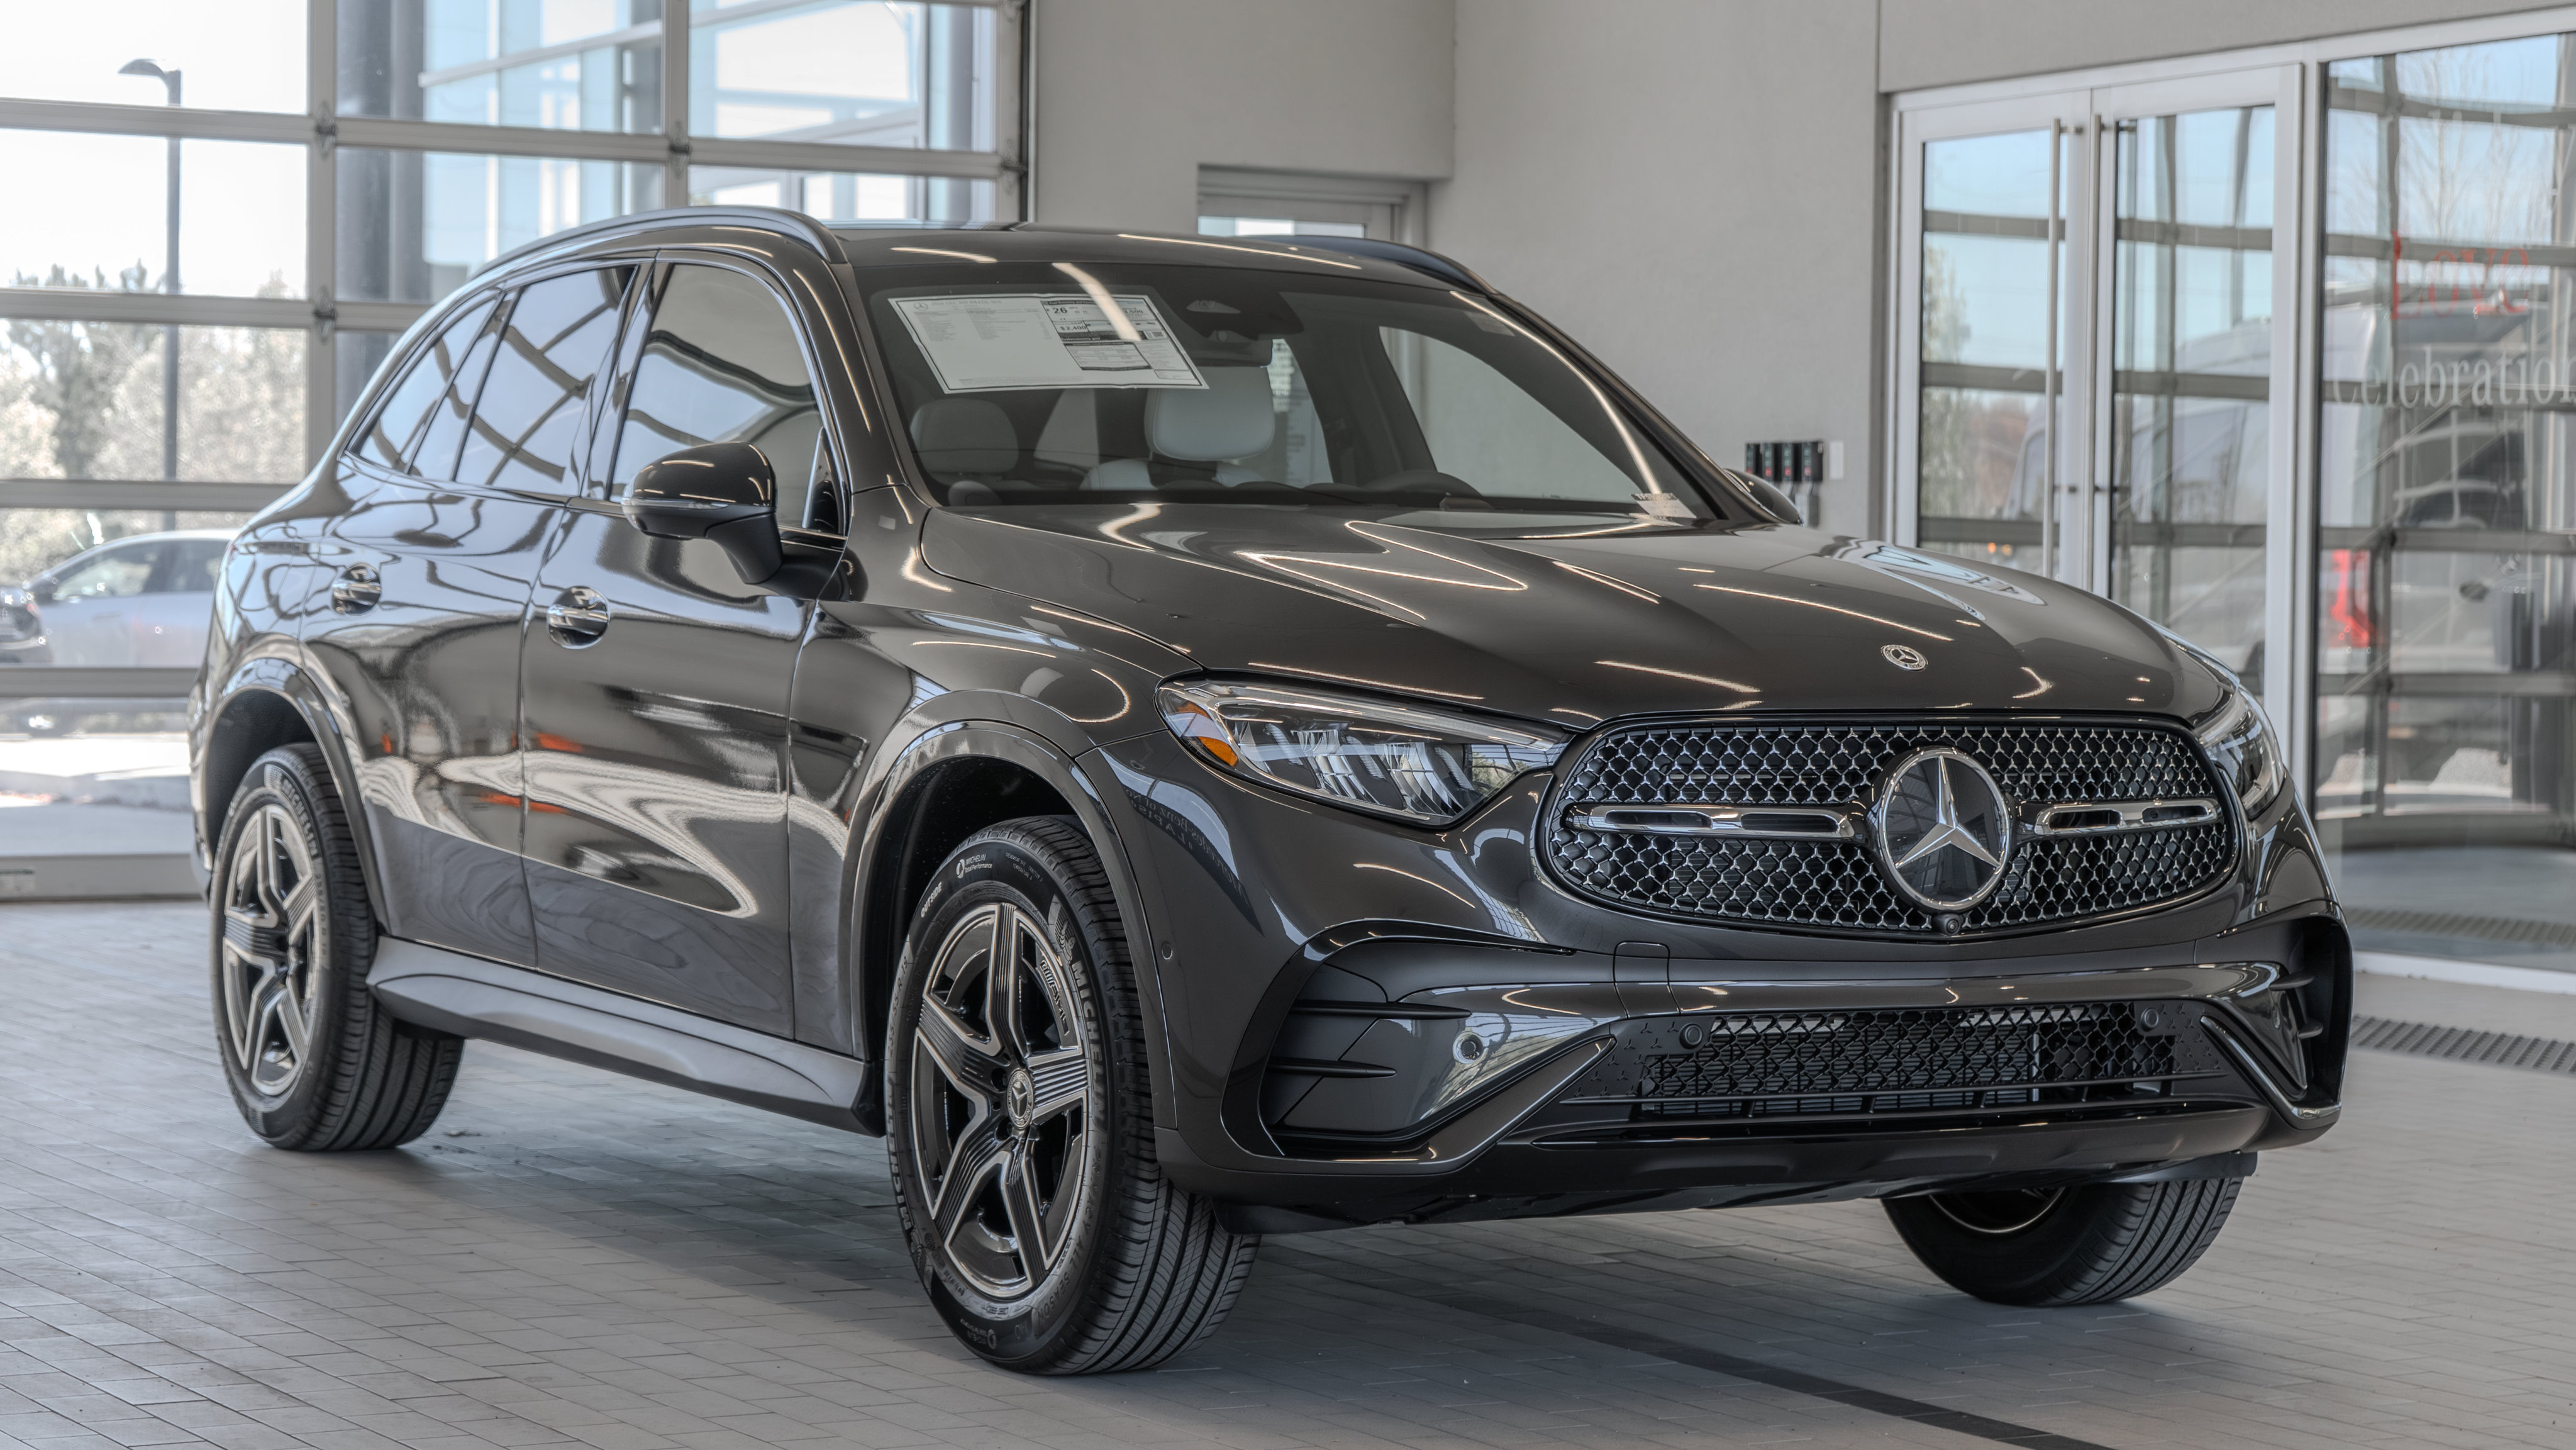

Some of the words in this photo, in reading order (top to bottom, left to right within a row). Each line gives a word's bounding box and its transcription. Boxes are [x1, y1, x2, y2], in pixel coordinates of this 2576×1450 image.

[280, 777, 319, 858] MICHELIN
[965, 854, 987, 864] MICHELIN
[972, 862, 993, 871] Performance
[921, 881, 942, 918] OUTSIDE
[901, 955, 908, 975] 19
[1071, 960, 1105, 1120] MICHELIN
[887, 1076, 912, 1230] MICHELIN
[1070, 1235, 1084, 1268] ALL
[1038, 1271, 1070, 1320] SEASON
